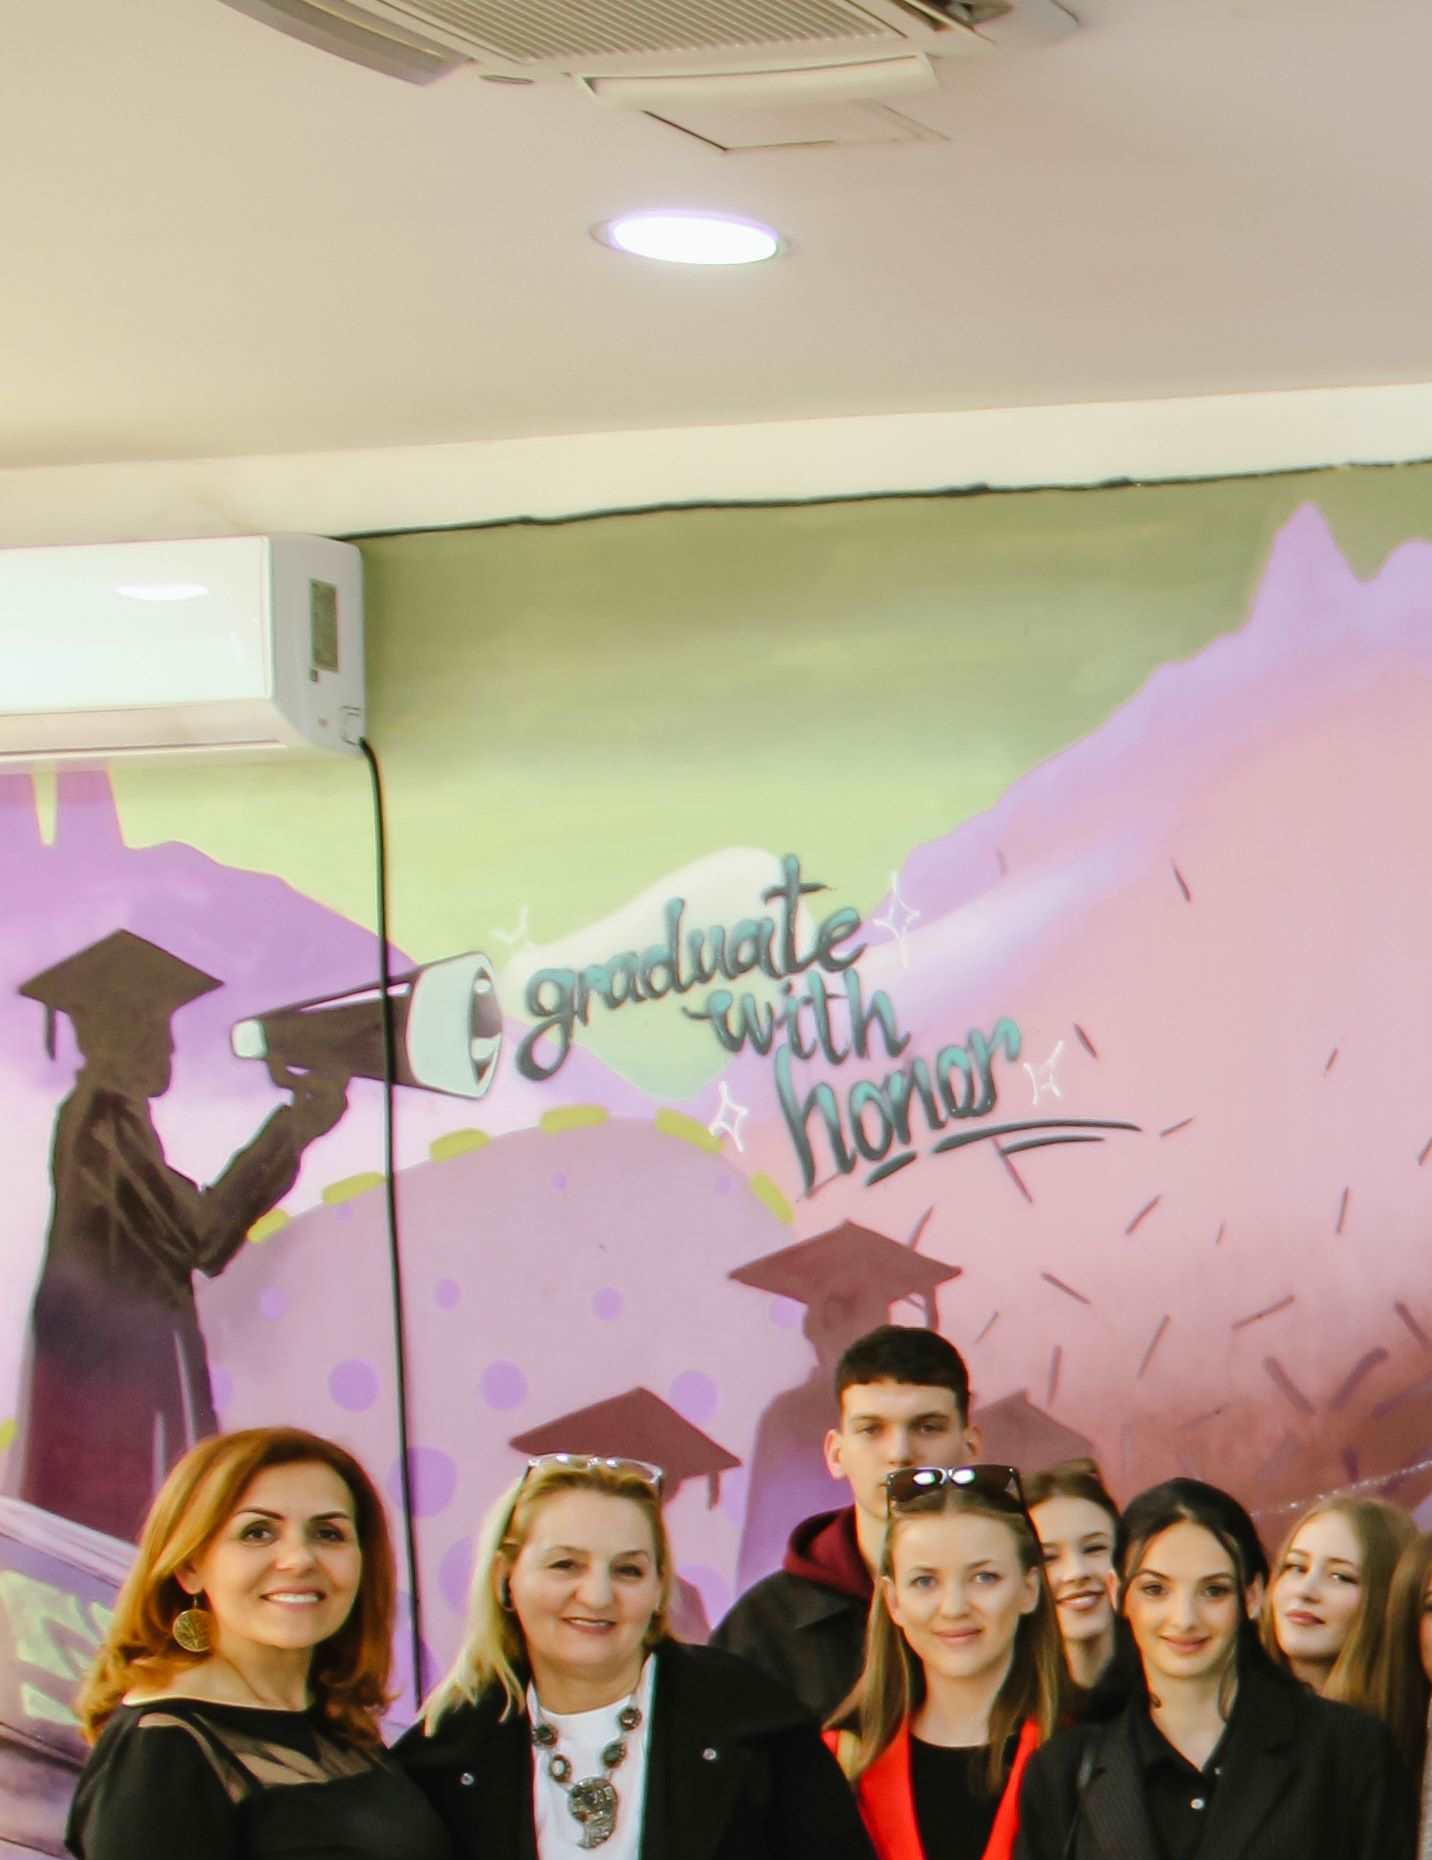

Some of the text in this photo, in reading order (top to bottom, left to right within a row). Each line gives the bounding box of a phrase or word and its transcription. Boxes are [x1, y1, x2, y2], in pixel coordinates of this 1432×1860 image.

[515, 851, 868, 1083] graduate
[681, 966, 911, 1066] with
[773, 1015, 1023, 1199] honor
